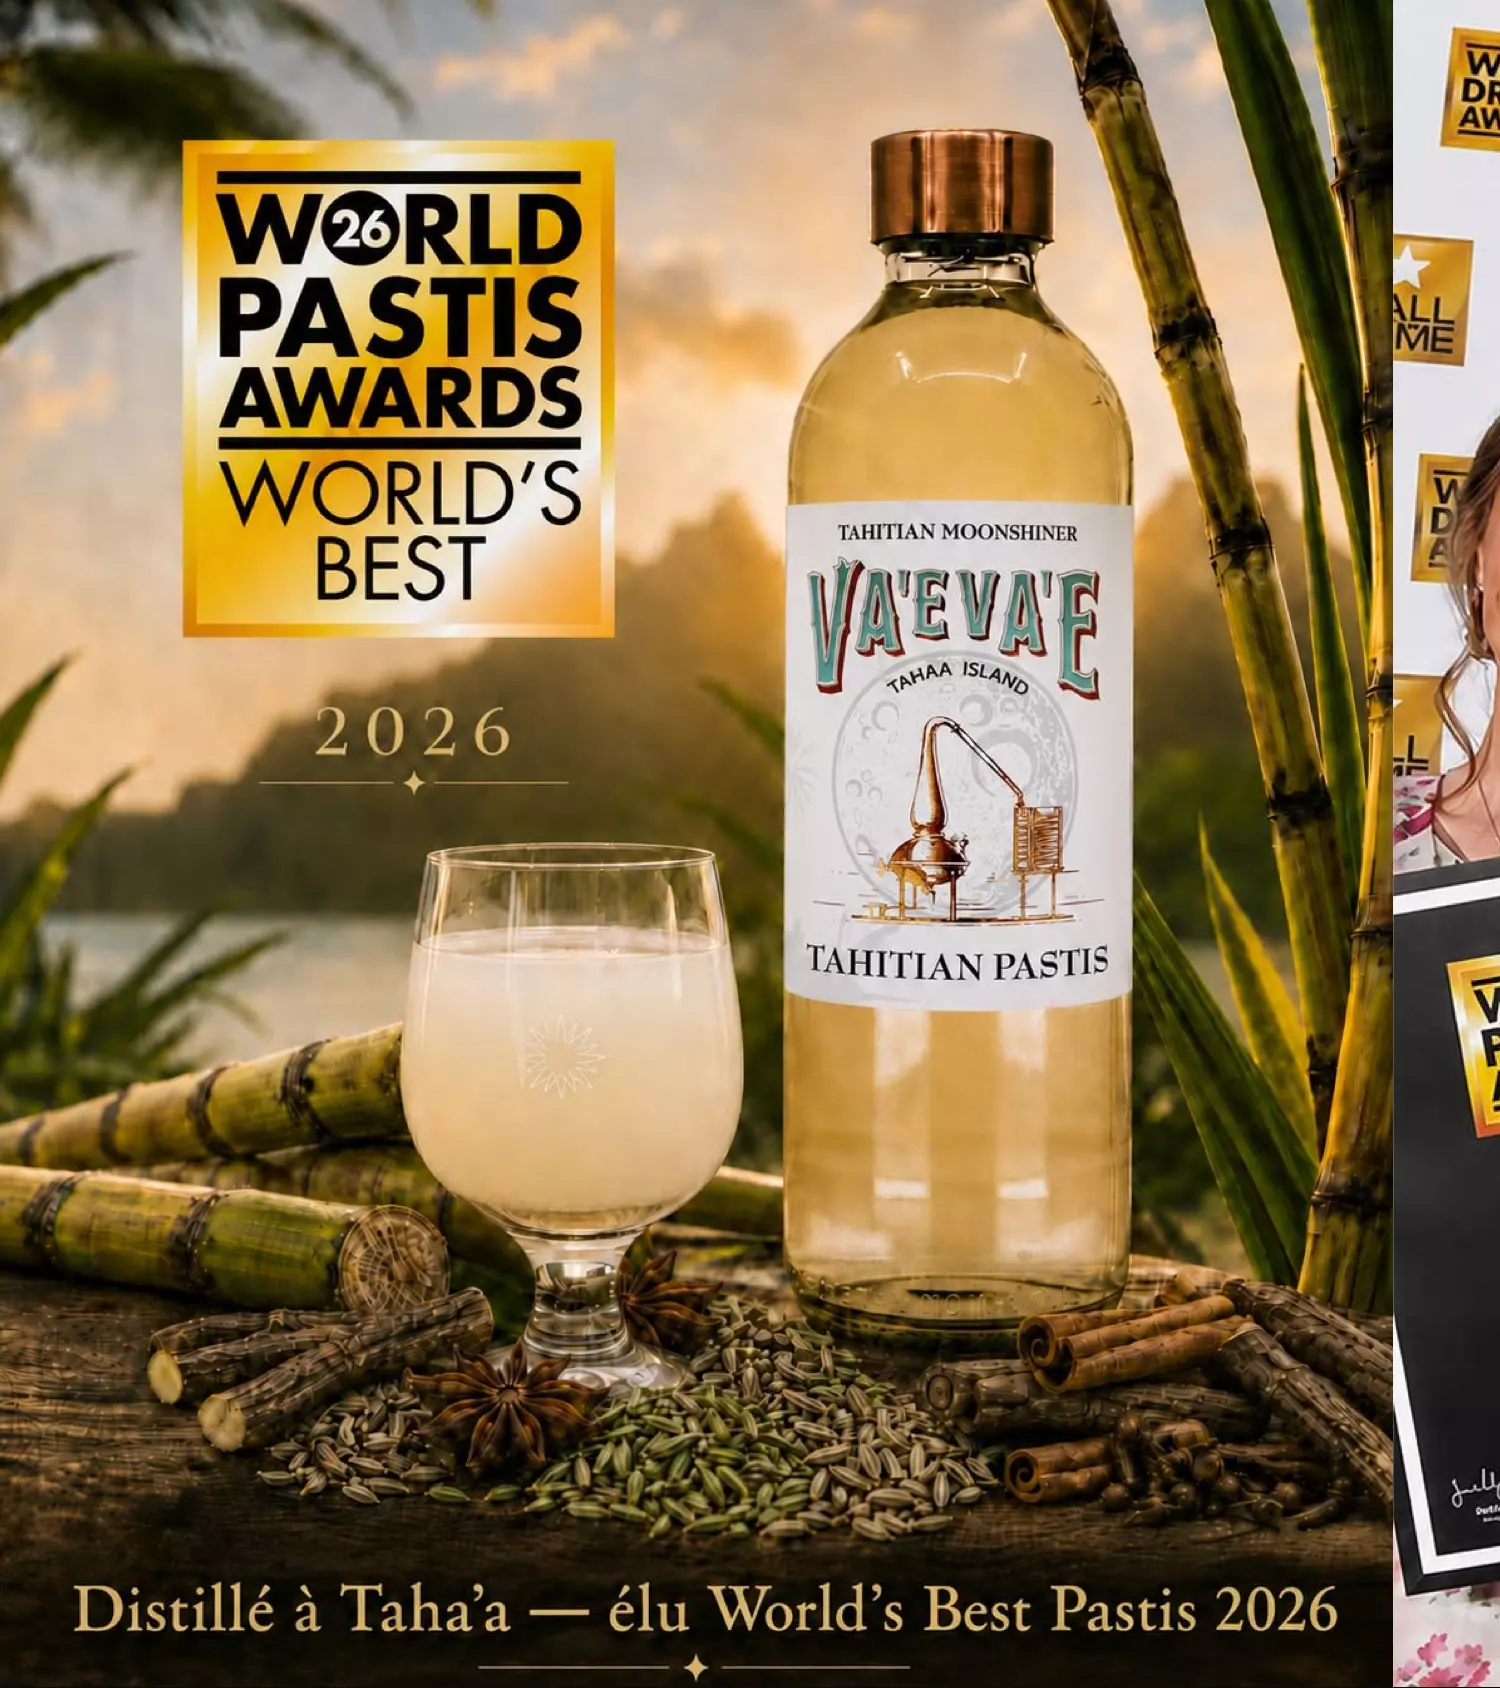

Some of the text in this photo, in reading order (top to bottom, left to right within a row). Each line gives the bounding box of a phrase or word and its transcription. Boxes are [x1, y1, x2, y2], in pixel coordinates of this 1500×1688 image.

[1393, 293, 1454, 325] ALL
[1395, 323, 1454, 354] ME
[838, 523, 1078, 542] TAHITIAN MOONSHINER
[886, 661, 1030, 697] TAHAA ISLAND
[806, 943, 1110, 982] TAHITIAN PASTIS
